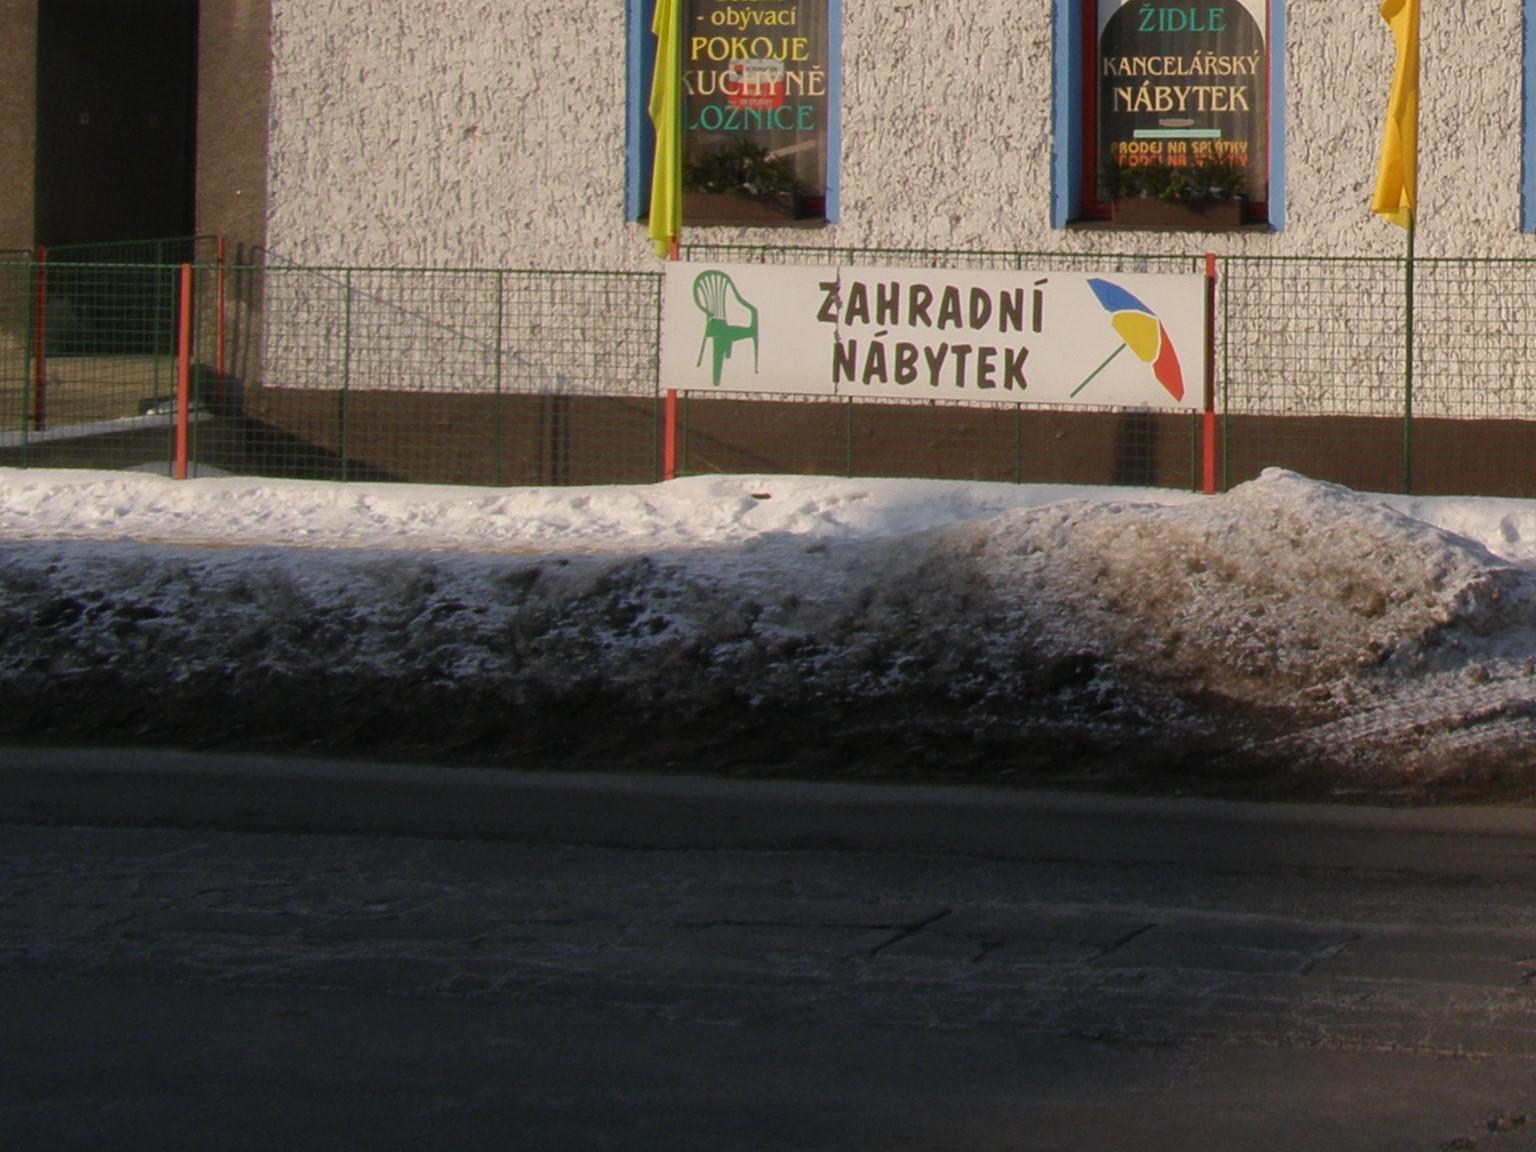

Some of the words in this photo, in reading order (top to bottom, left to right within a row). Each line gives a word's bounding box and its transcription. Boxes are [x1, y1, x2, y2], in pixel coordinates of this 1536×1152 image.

[711, 6, 797, 31] obývací
[1137, 3, 1226, 32] ŽIDLE
[691, 36, 810, 61] POKOJE
[1103, 49, 1261, 76] KANCELÁŘSKÝ
[1113, 79, 1250, 112] NÁBYTEK
[1167, 141, 1187, 155] NA
[816, 277, 1049, 334] ZAHRADNÍ
[833, 329, 1031, 391] NÁBYTEK
